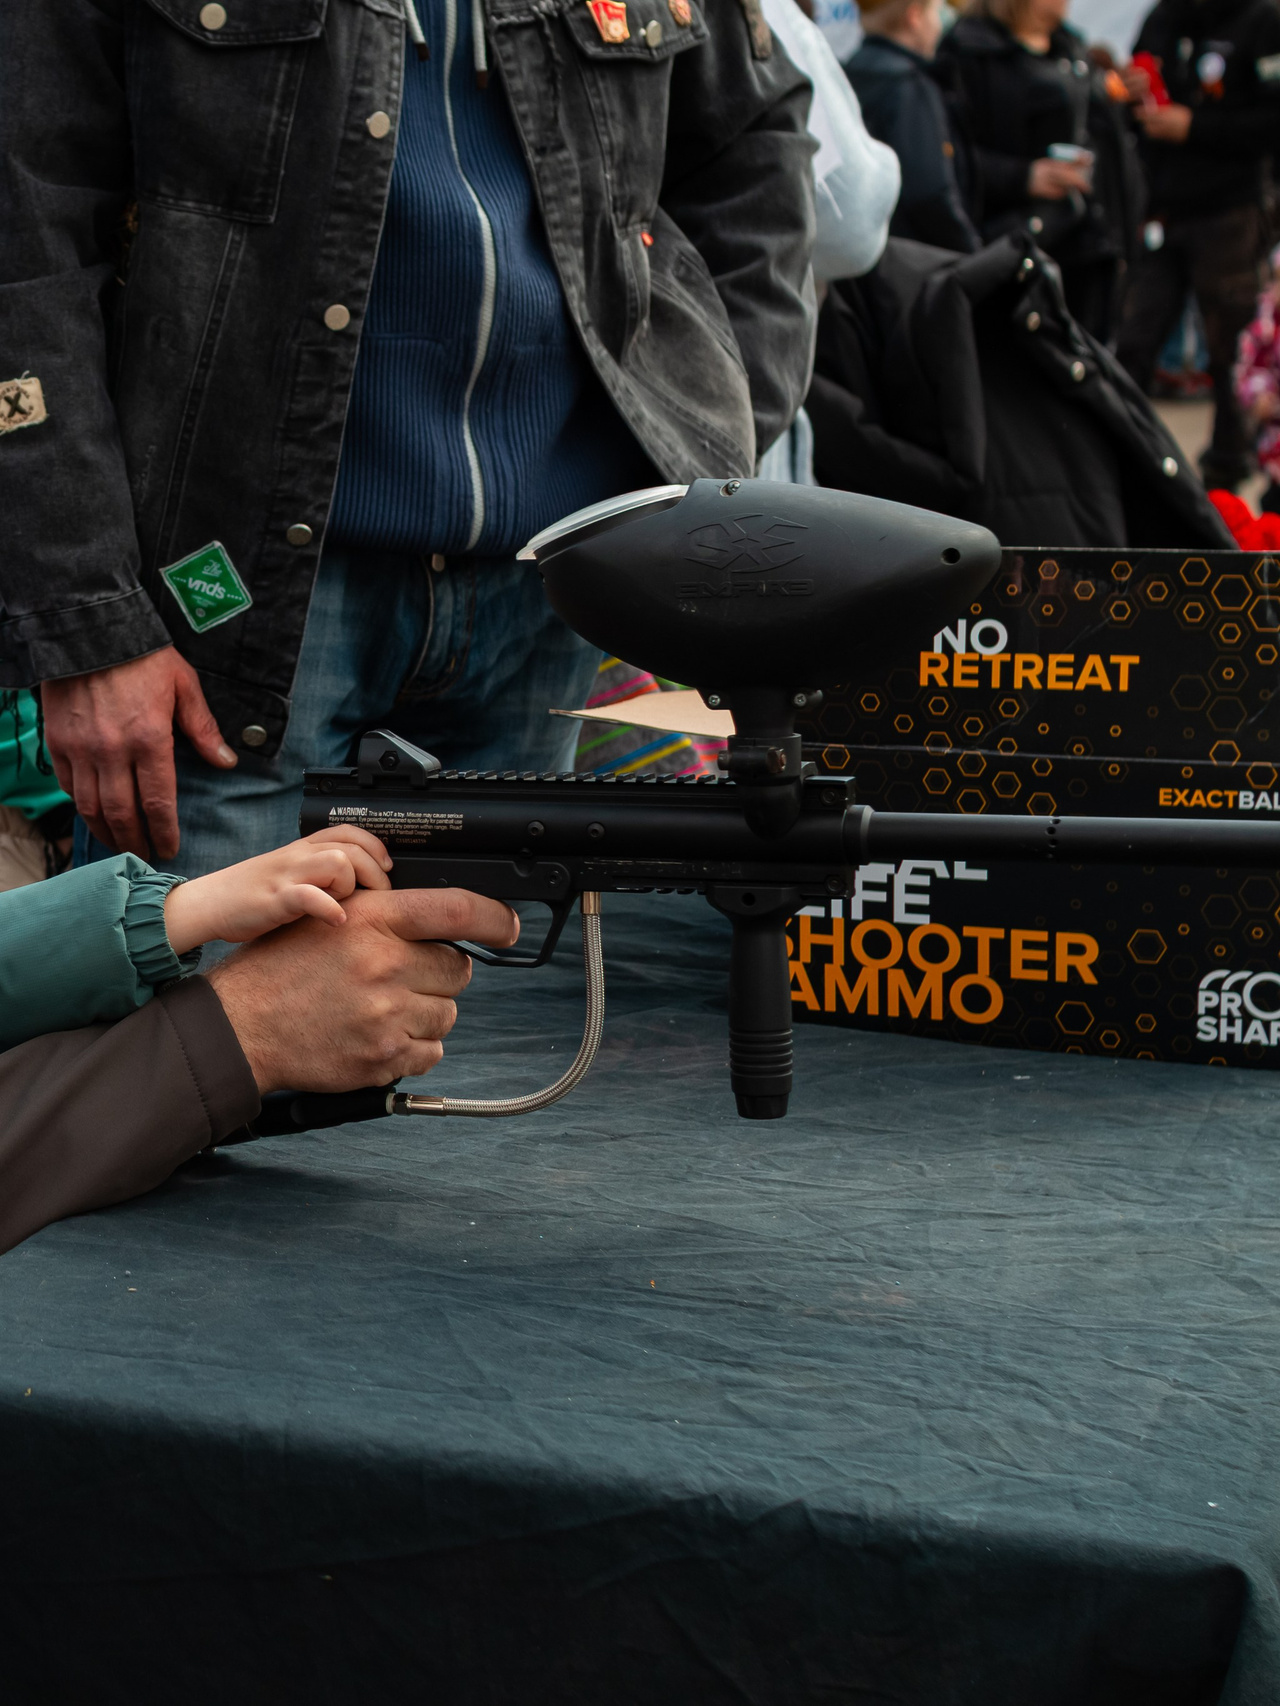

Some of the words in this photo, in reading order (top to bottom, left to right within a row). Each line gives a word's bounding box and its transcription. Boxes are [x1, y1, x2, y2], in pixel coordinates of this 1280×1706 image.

[187, 577, 227, 600] vnds
[933, 619, 1008, 655] NO
[920, 651, 1140, 692] RETREAT
[337, 807, 368, 816] WARNING!
[789, 960, 1004, 1025] AMMO
